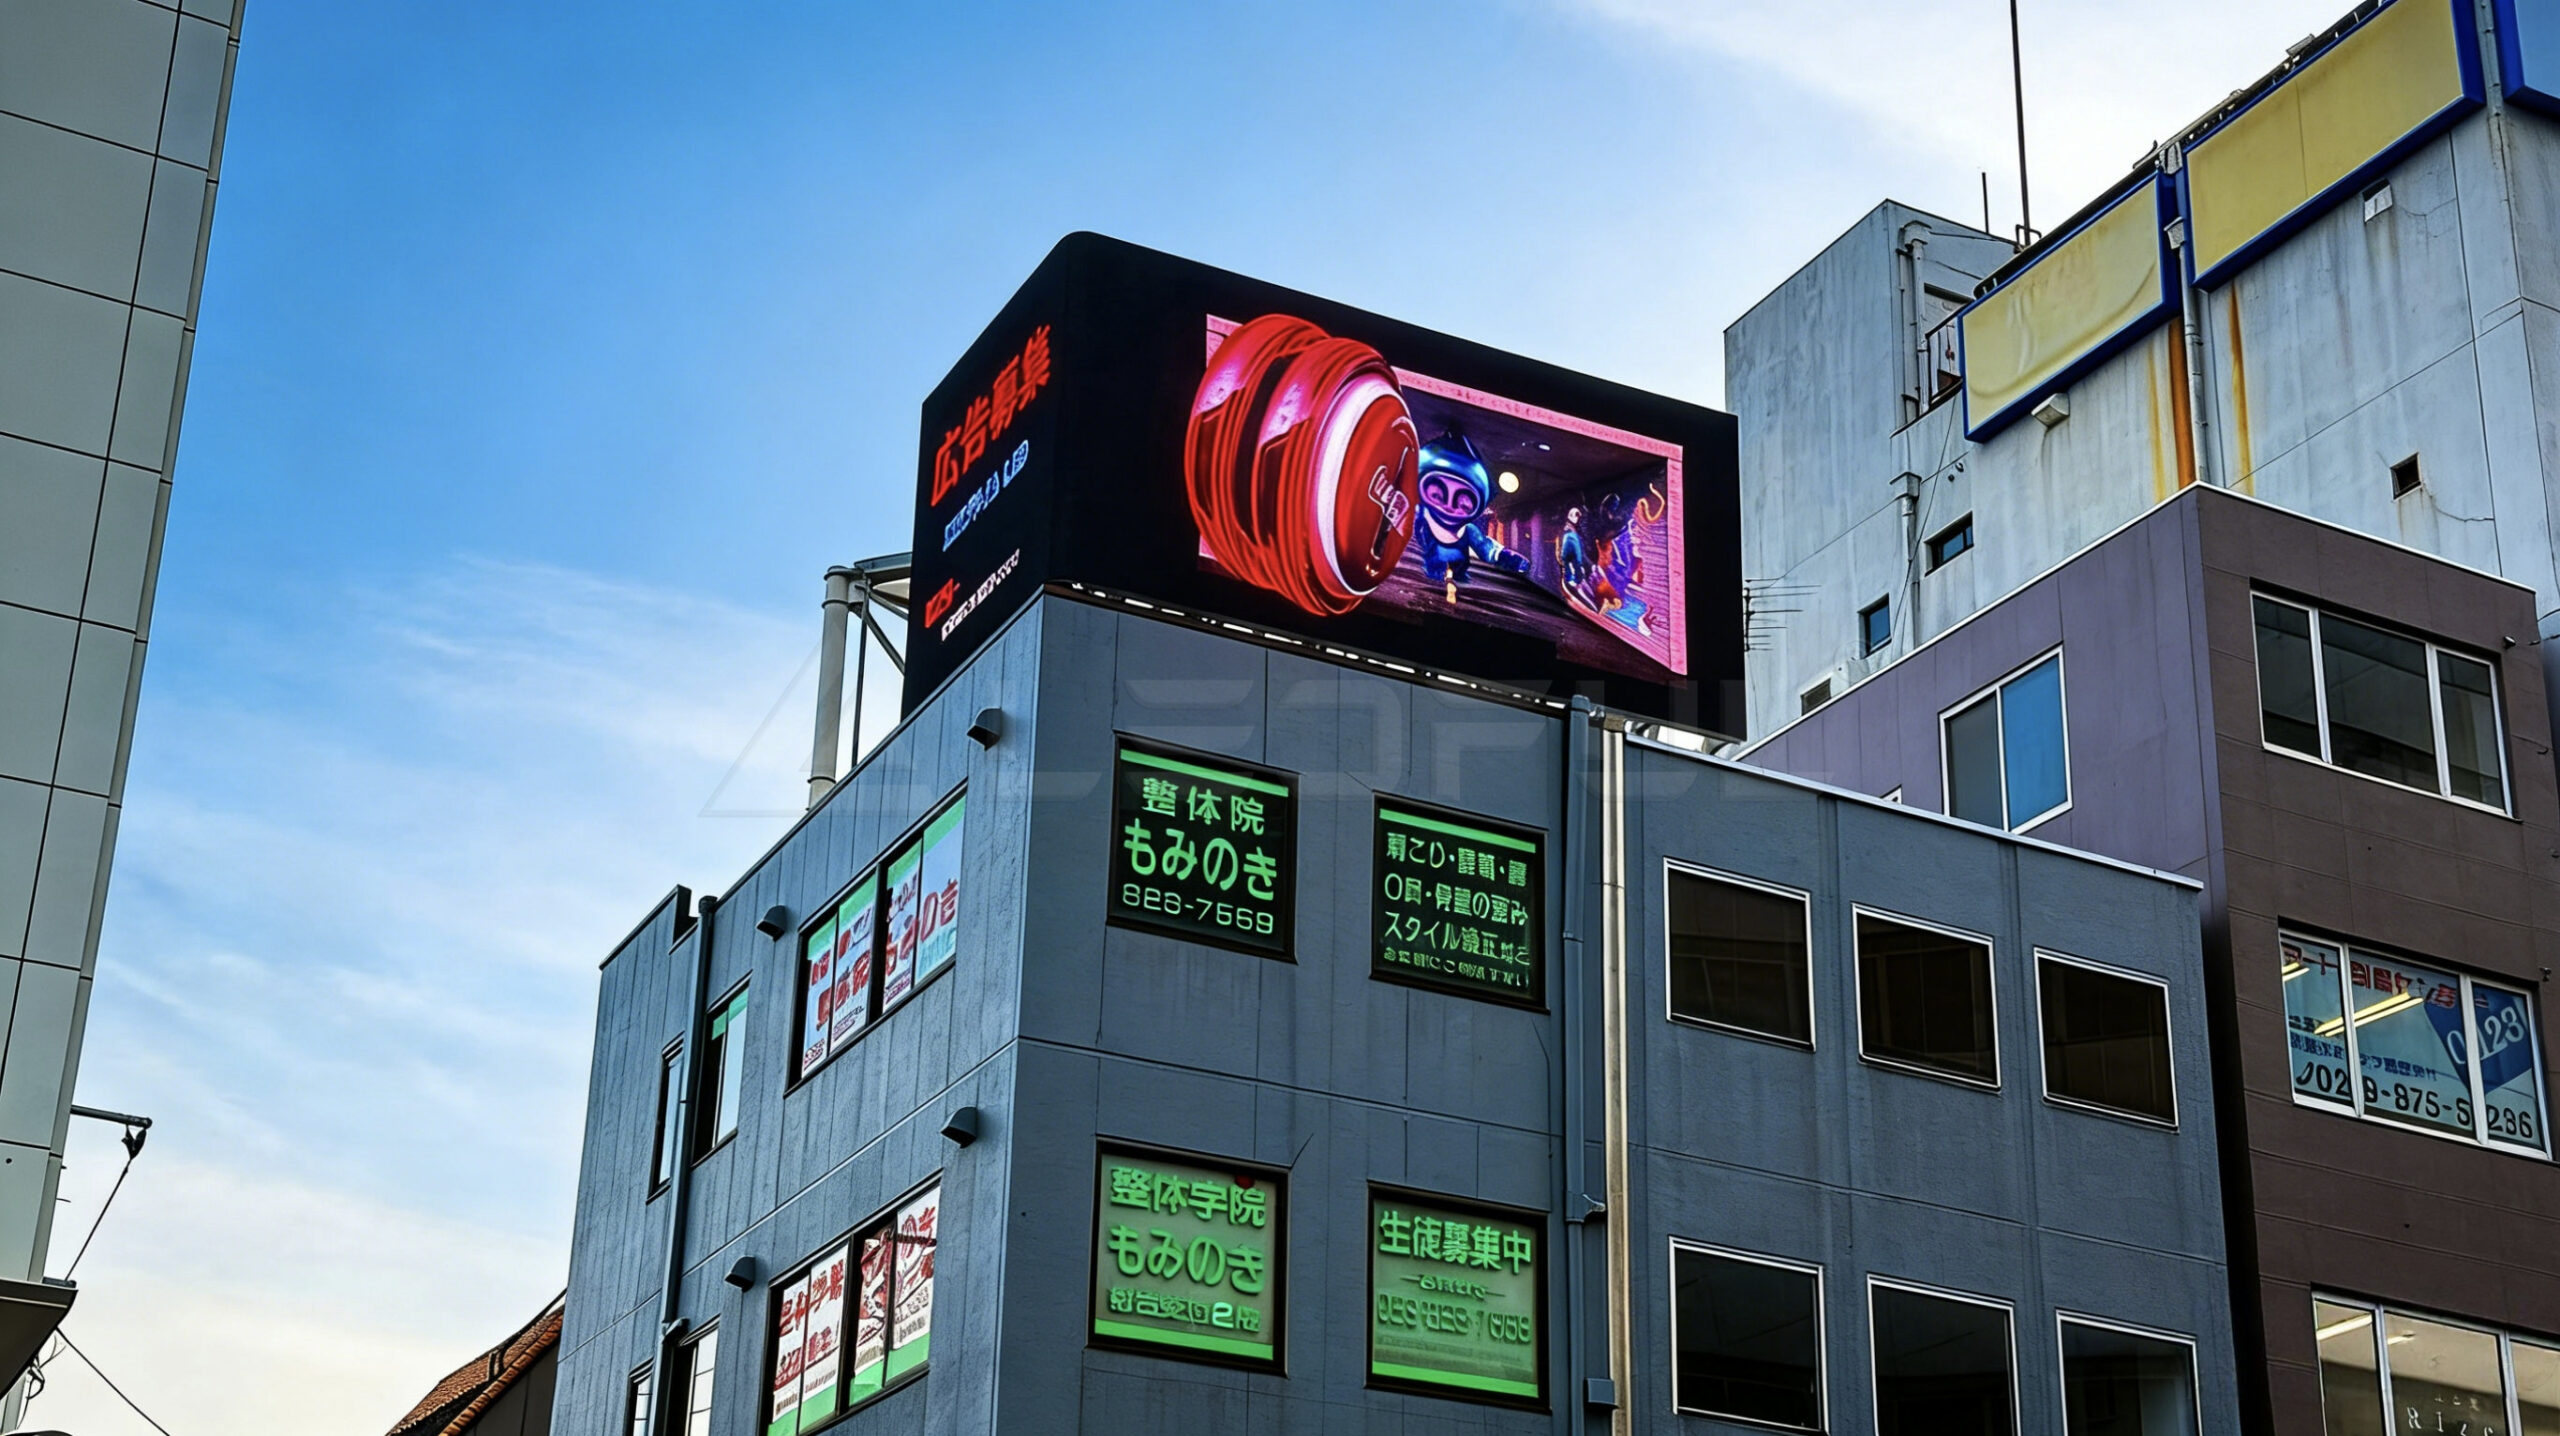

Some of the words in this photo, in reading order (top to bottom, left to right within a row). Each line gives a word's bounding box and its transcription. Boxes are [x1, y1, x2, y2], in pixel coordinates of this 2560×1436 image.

[1142, 777, 1265, 835] 整体院
[1123, 817, 1278, 901] もみのき
[1110, 1165, 1266, 1227] 整体学院
[1109, 1224, 1265, 1295] もみのき
[1379, 1210, 1532, 1275] 生徒募集中
